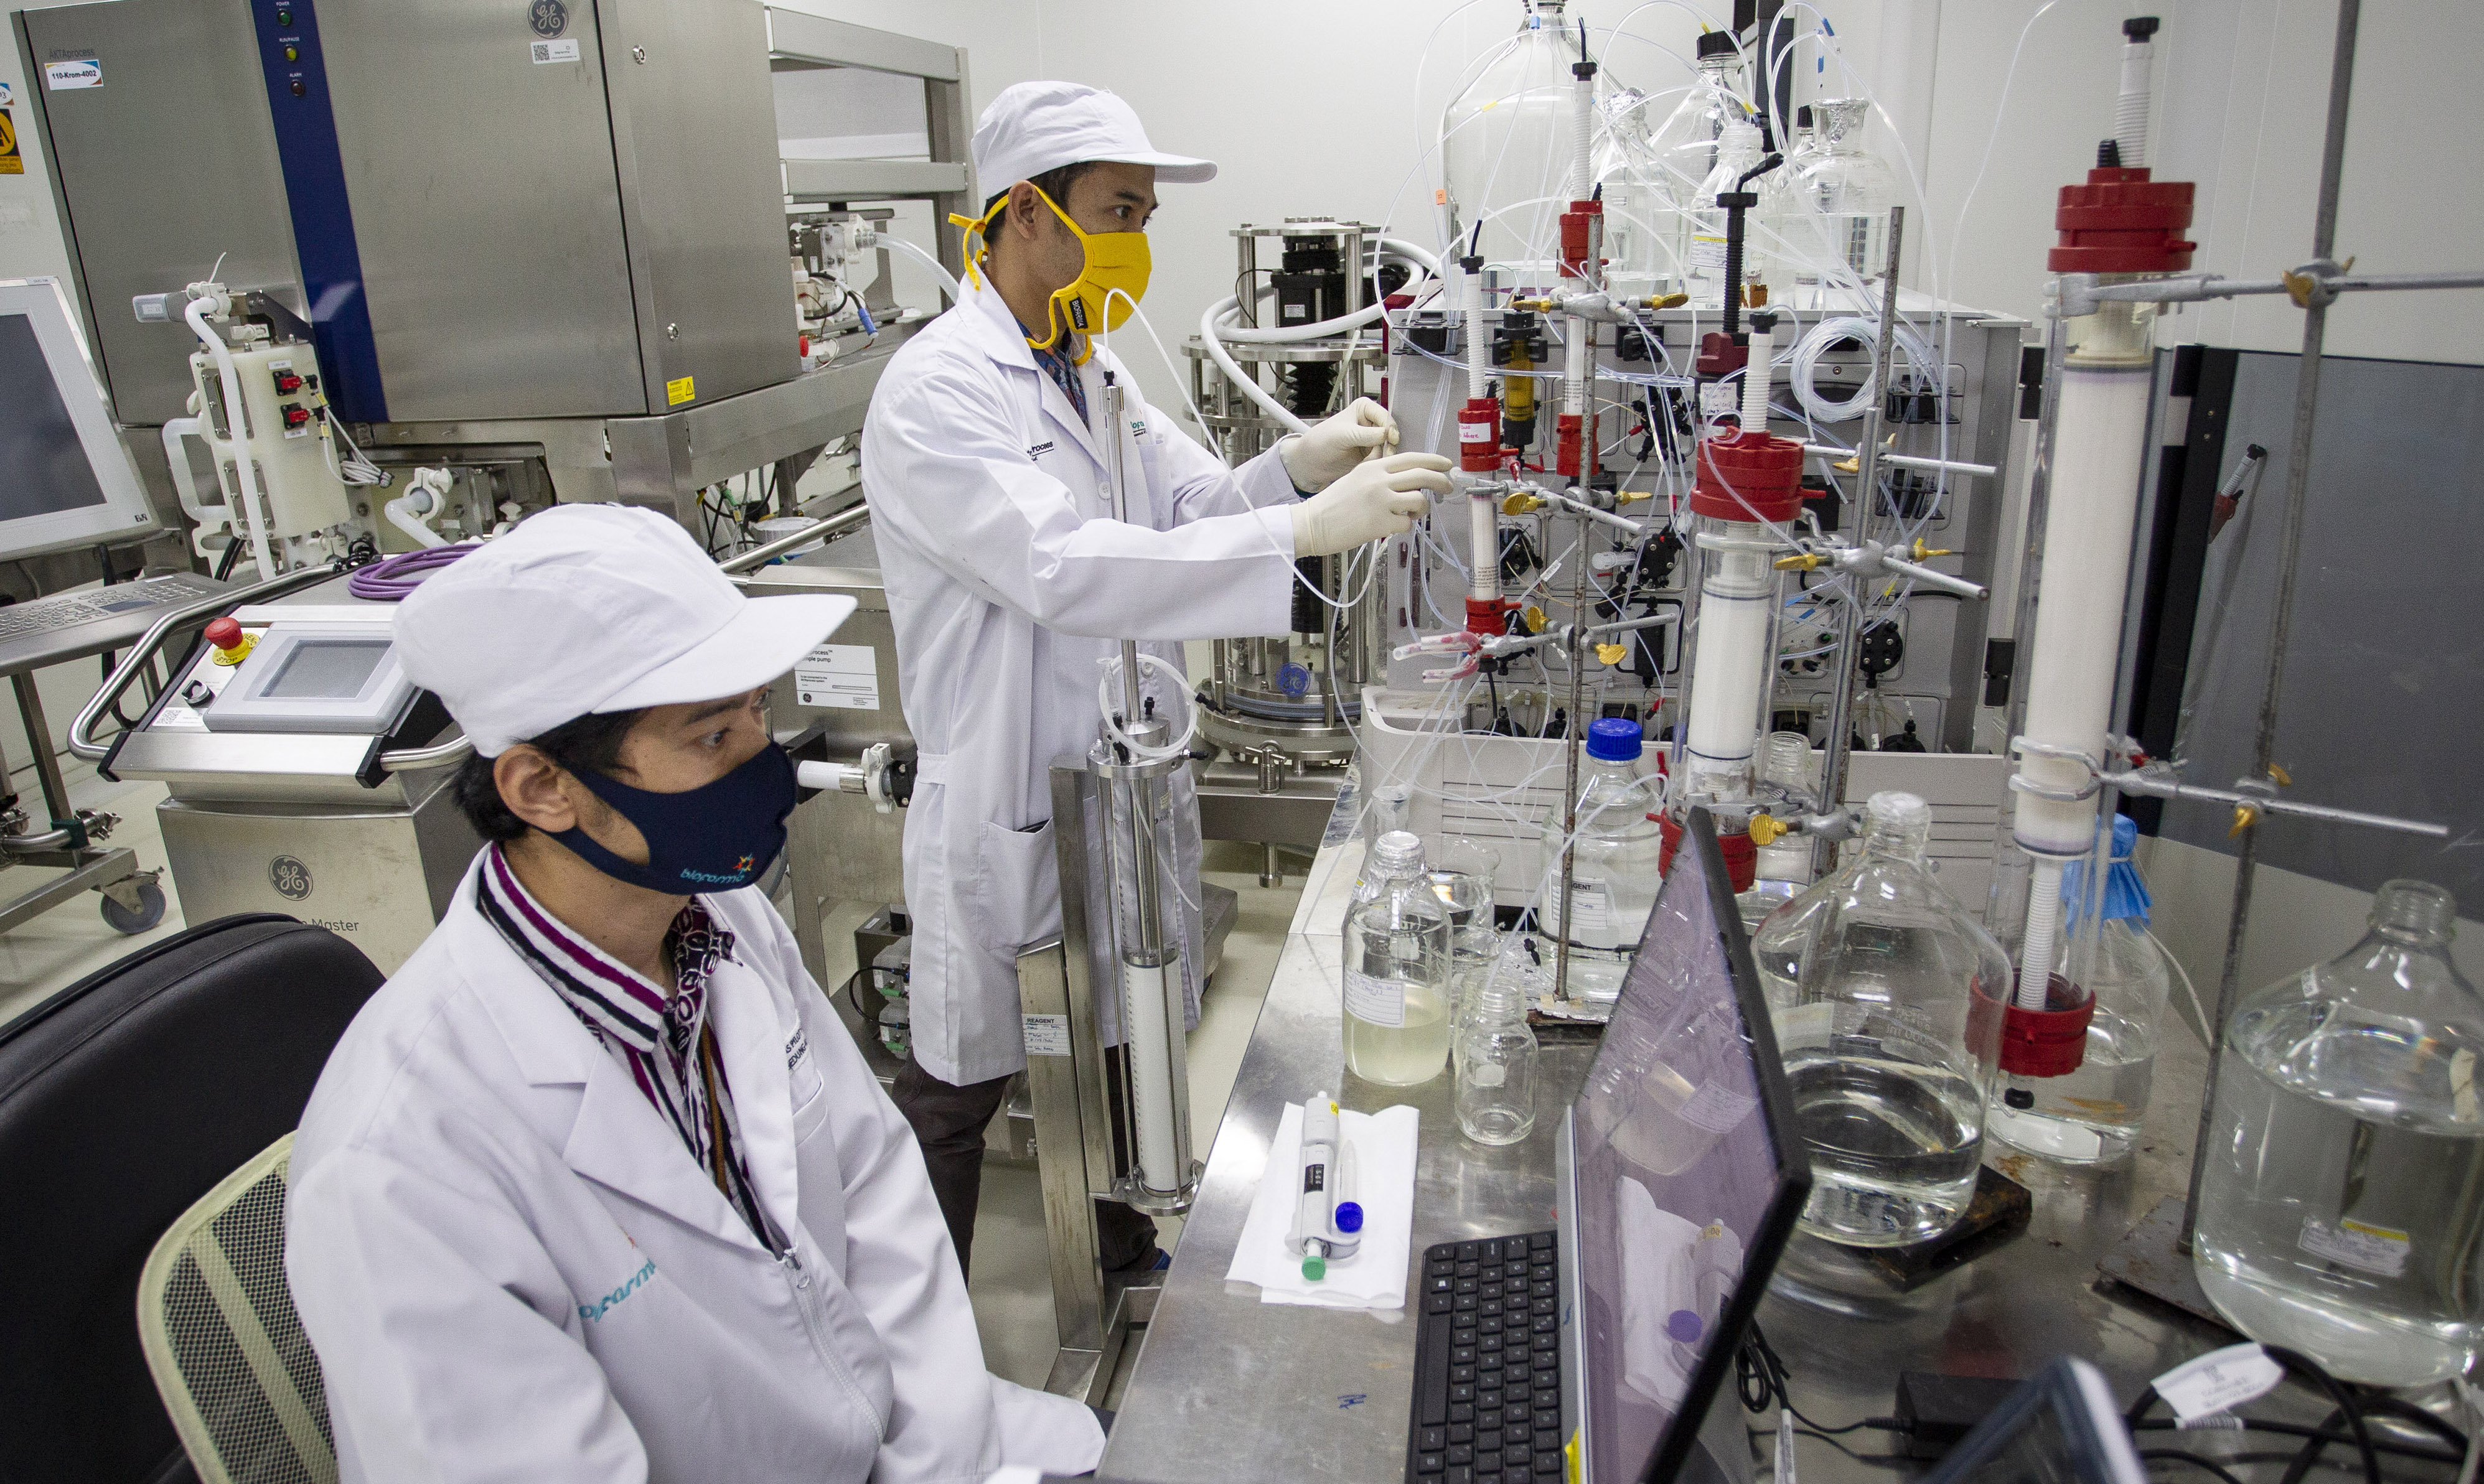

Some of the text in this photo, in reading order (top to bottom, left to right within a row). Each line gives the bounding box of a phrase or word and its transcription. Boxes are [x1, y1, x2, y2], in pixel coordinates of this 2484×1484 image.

[52, 70, 97, 80] 110-Krom-4002
[1072, 300, 1085, 328] BIOFARMA
[680, 868, 744, 884] biofarma
[312, 918, 359, 931] Master
